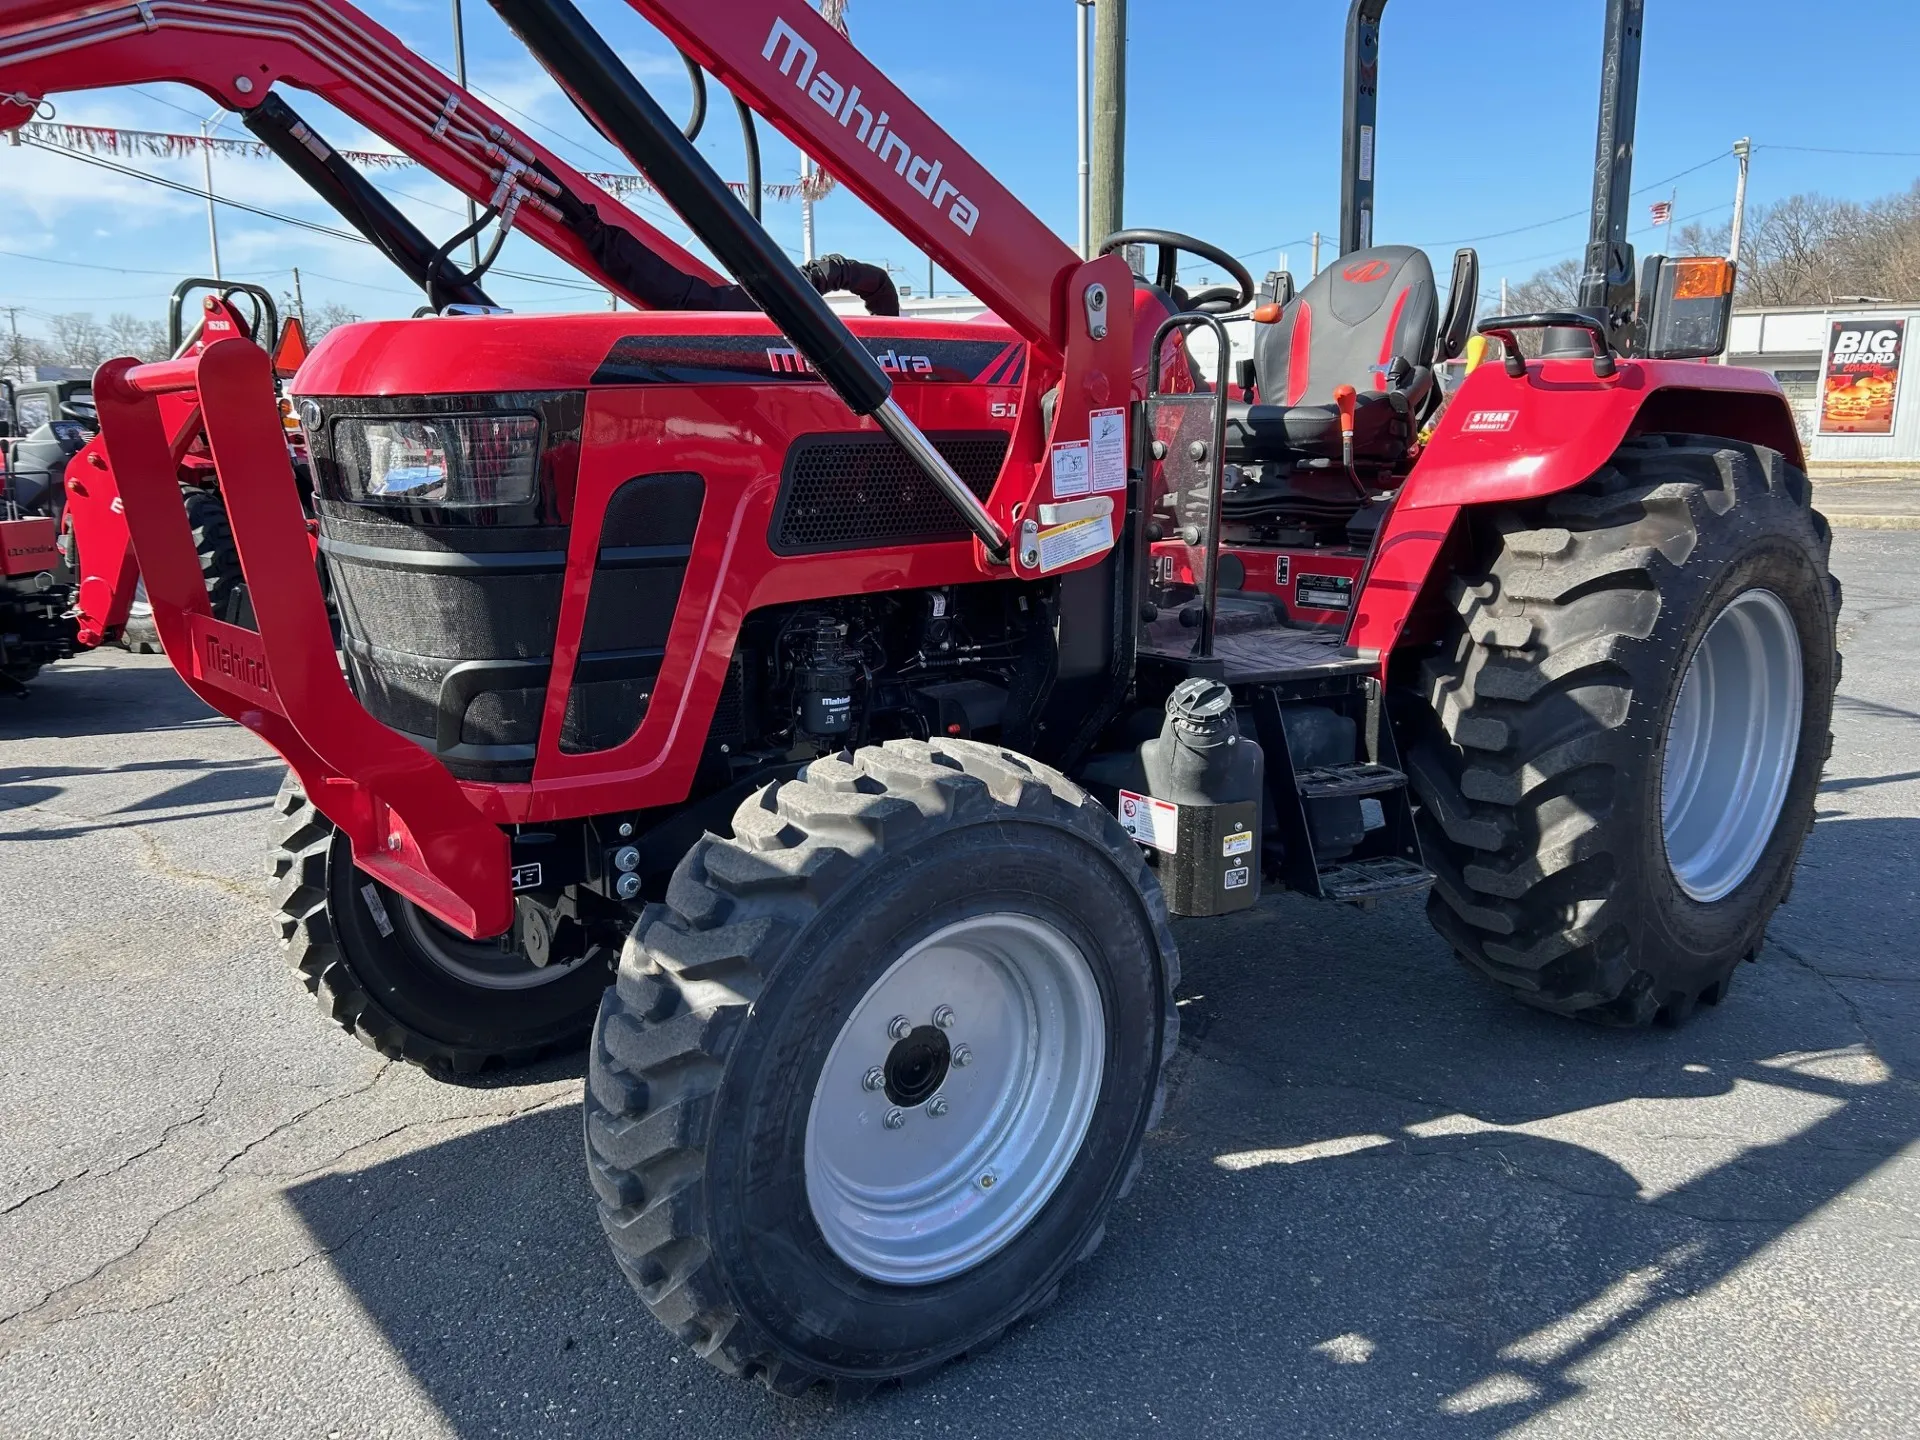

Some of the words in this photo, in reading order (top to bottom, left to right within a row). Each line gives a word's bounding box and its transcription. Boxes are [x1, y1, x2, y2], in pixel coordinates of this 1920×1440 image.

[761, 15, 980, 237] Mahindra
[1833, 329, 1899, 354] BIG
[1832, 351, 1896, 365] BUFORD
[1472, 412, 1482, 423] 5
[1482, 412, 1511, 422] YEAR
